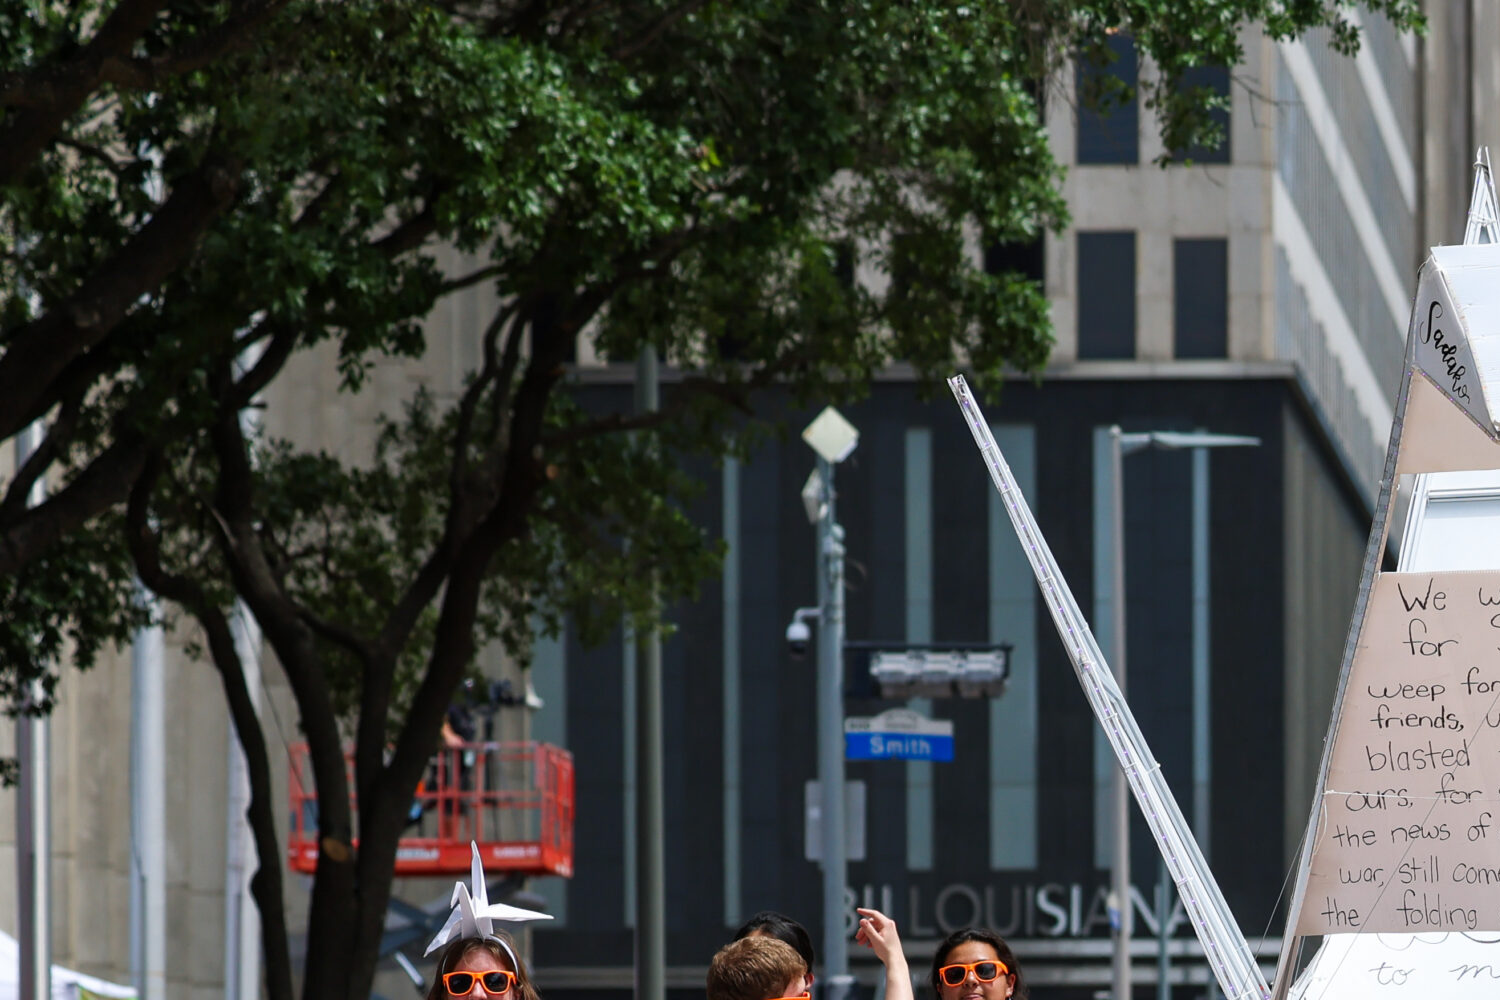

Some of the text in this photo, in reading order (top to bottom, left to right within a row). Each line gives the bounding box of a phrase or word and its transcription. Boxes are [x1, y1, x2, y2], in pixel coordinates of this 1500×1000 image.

[1419, 300, 1471, 405] Sadako
[1397, 578, 1447, 612] We
[1403, 618, 1459, 657] for
[1368, 682, 1445, 701] weep
[1370, 706, 1465, 732] friends,
[870, 735, 931, 754] Smith
[1366, 739, 1471, 772] blasted
[1345, 789, 1413, 812] ours,
[1435, 772, 1483, 805] for
[1333, 824, 1377, 847] the
[1391, 824, 1450, 843] news
[1467, 812, 1492, 841] of
[1340, 867, 1386, 888] war,
[1398, 855, 1439, 884] still
[1321, 895, 1361, 928] the
[1396, 889, 1478, 930] folding
[1369, 961, 1415, 986] to
